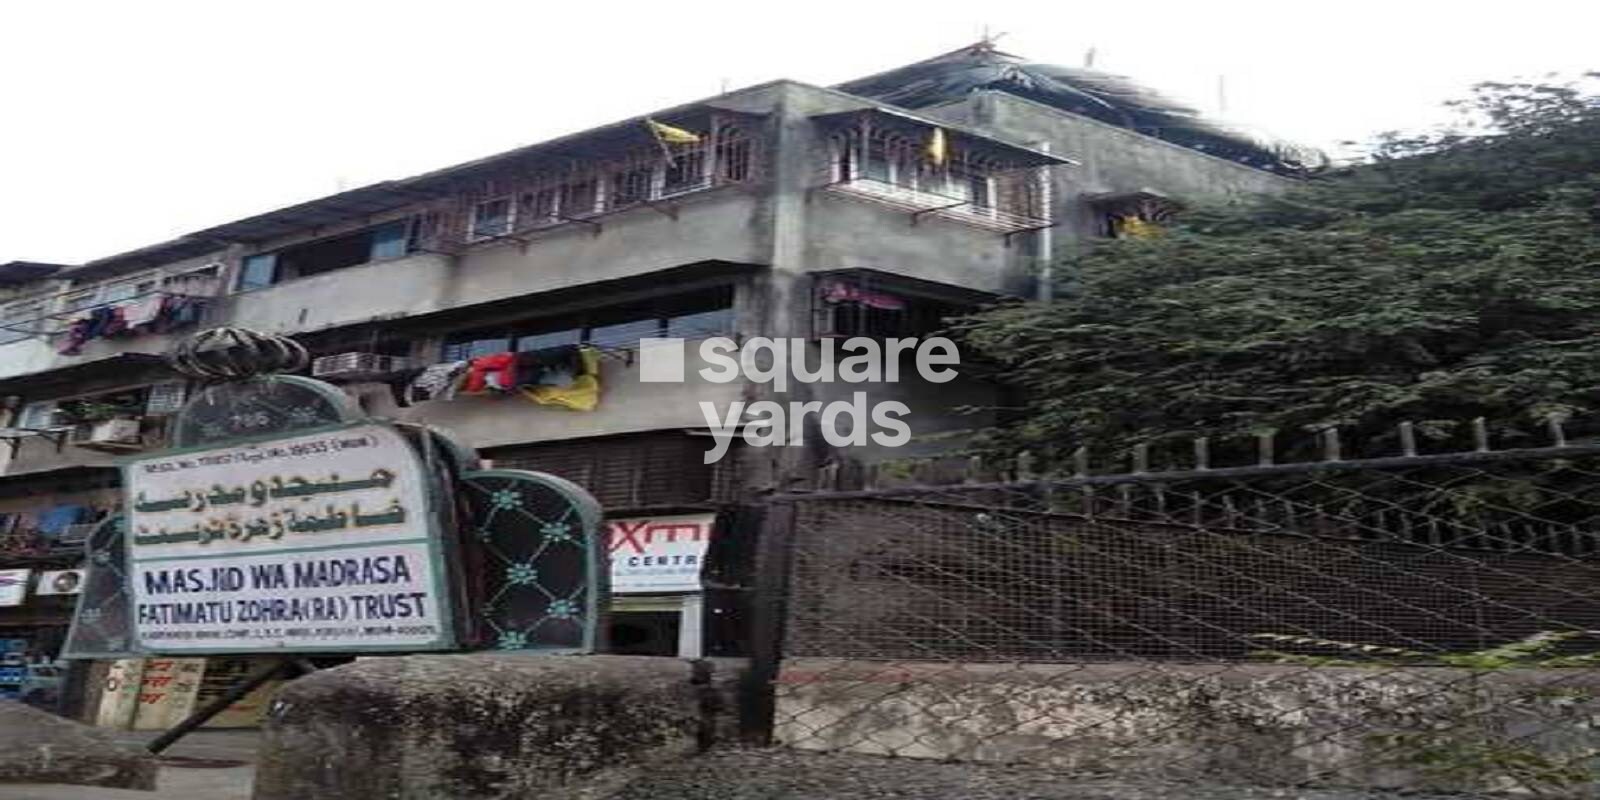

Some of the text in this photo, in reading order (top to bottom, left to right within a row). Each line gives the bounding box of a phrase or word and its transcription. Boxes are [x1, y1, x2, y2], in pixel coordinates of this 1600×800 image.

[144, 555, 411, 595] MASJID WA MADRASA
[138, 600, 232, 624] FATIMATU
[352, 592, 427, 620] TRUST
